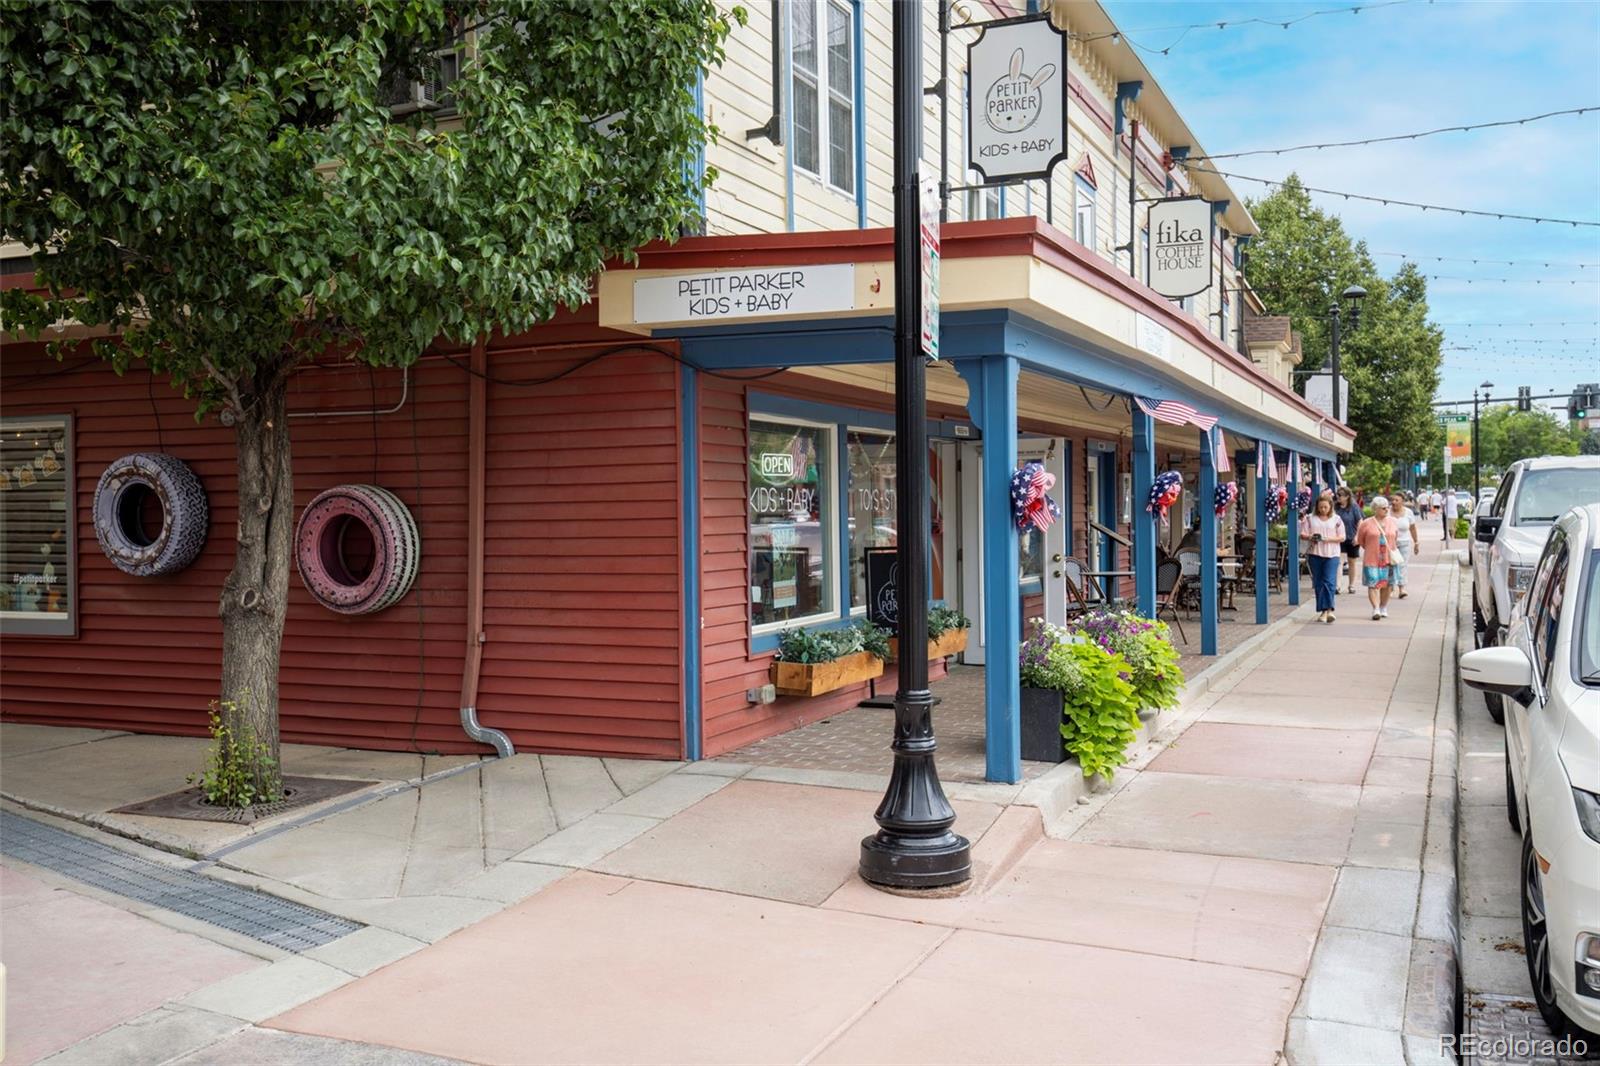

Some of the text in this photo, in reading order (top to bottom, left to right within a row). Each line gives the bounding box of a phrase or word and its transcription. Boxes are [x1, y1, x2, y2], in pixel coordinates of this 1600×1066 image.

[979, 143, 1010, 157] KIDS
[1021, 138, 1054, 153] BABY
[1156, 219, 1203, 244] fika
[1155, 245, 1204, 259] COFFEE
[1158, 257, 1202, 271] HOUSE
[678, 271, 805, 296] PETIT PARKER
[689, 297, 730, 316] KIDS
[746, 292, 793, 312] BABY
[763, 456, 791, 474] OPEN
[750, 487, 777, 513] KIDS
[787, 487, 815, 512] BABY
